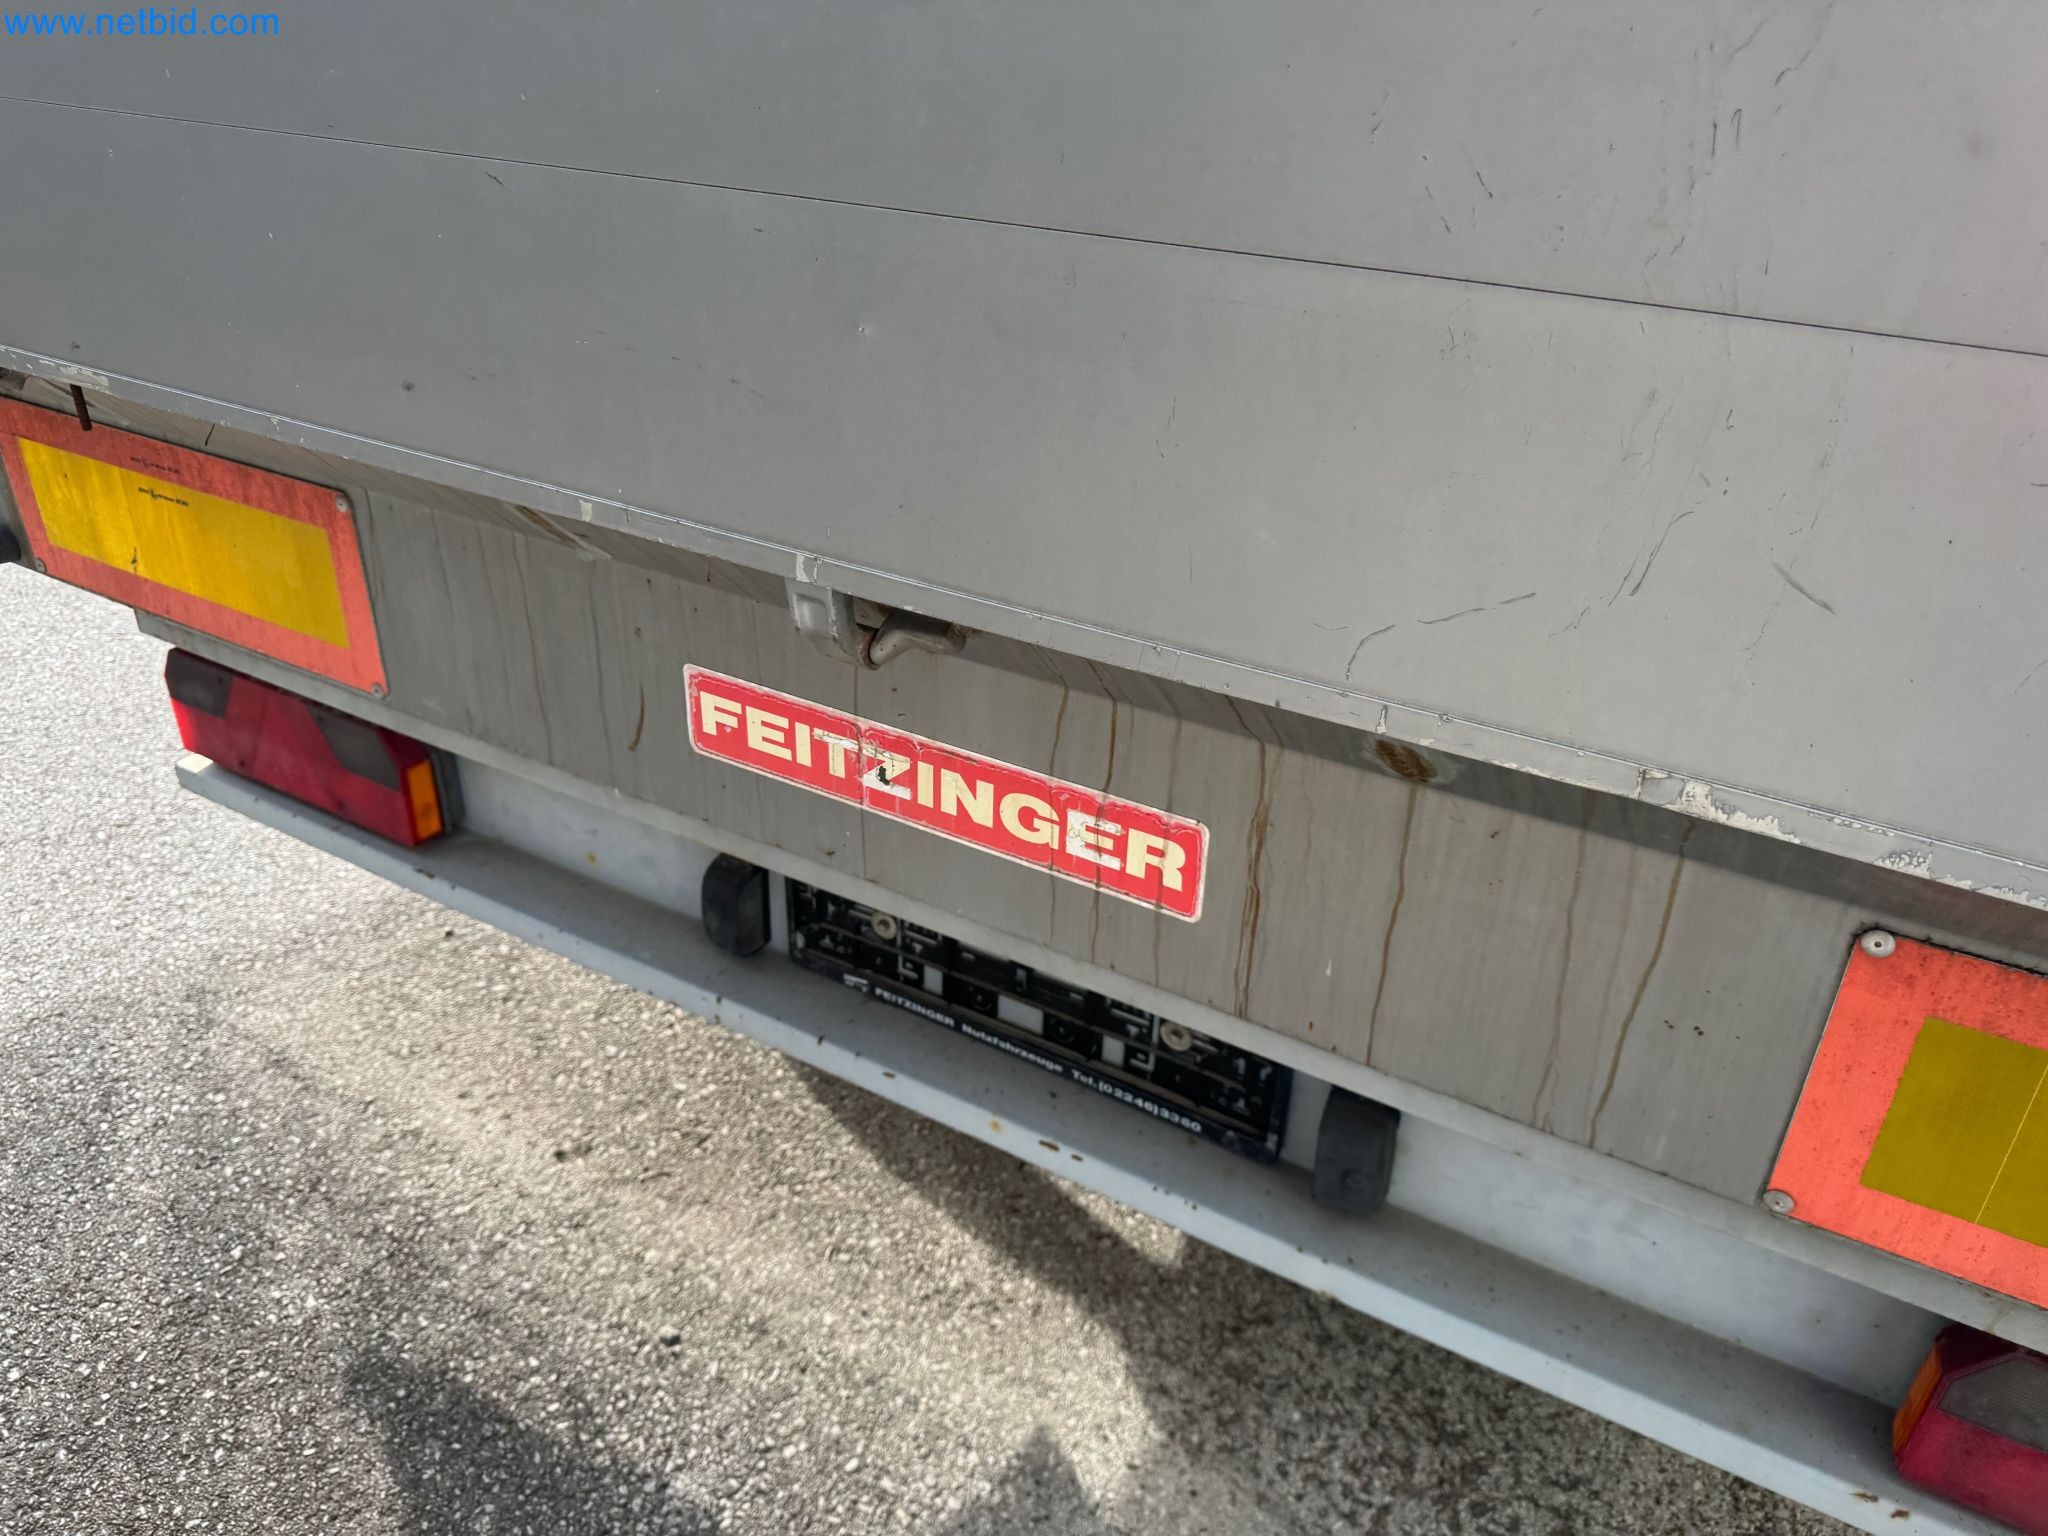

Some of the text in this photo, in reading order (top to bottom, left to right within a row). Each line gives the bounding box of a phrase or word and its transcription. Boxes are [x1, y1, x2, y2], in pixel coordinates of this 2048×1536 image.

[699, 690, 1186, 892] FEITZINGER
[875, 986, 955, 1028] FEITZINGER
[962, 1023, 1064, 1073] Nutzfahrzeuge
